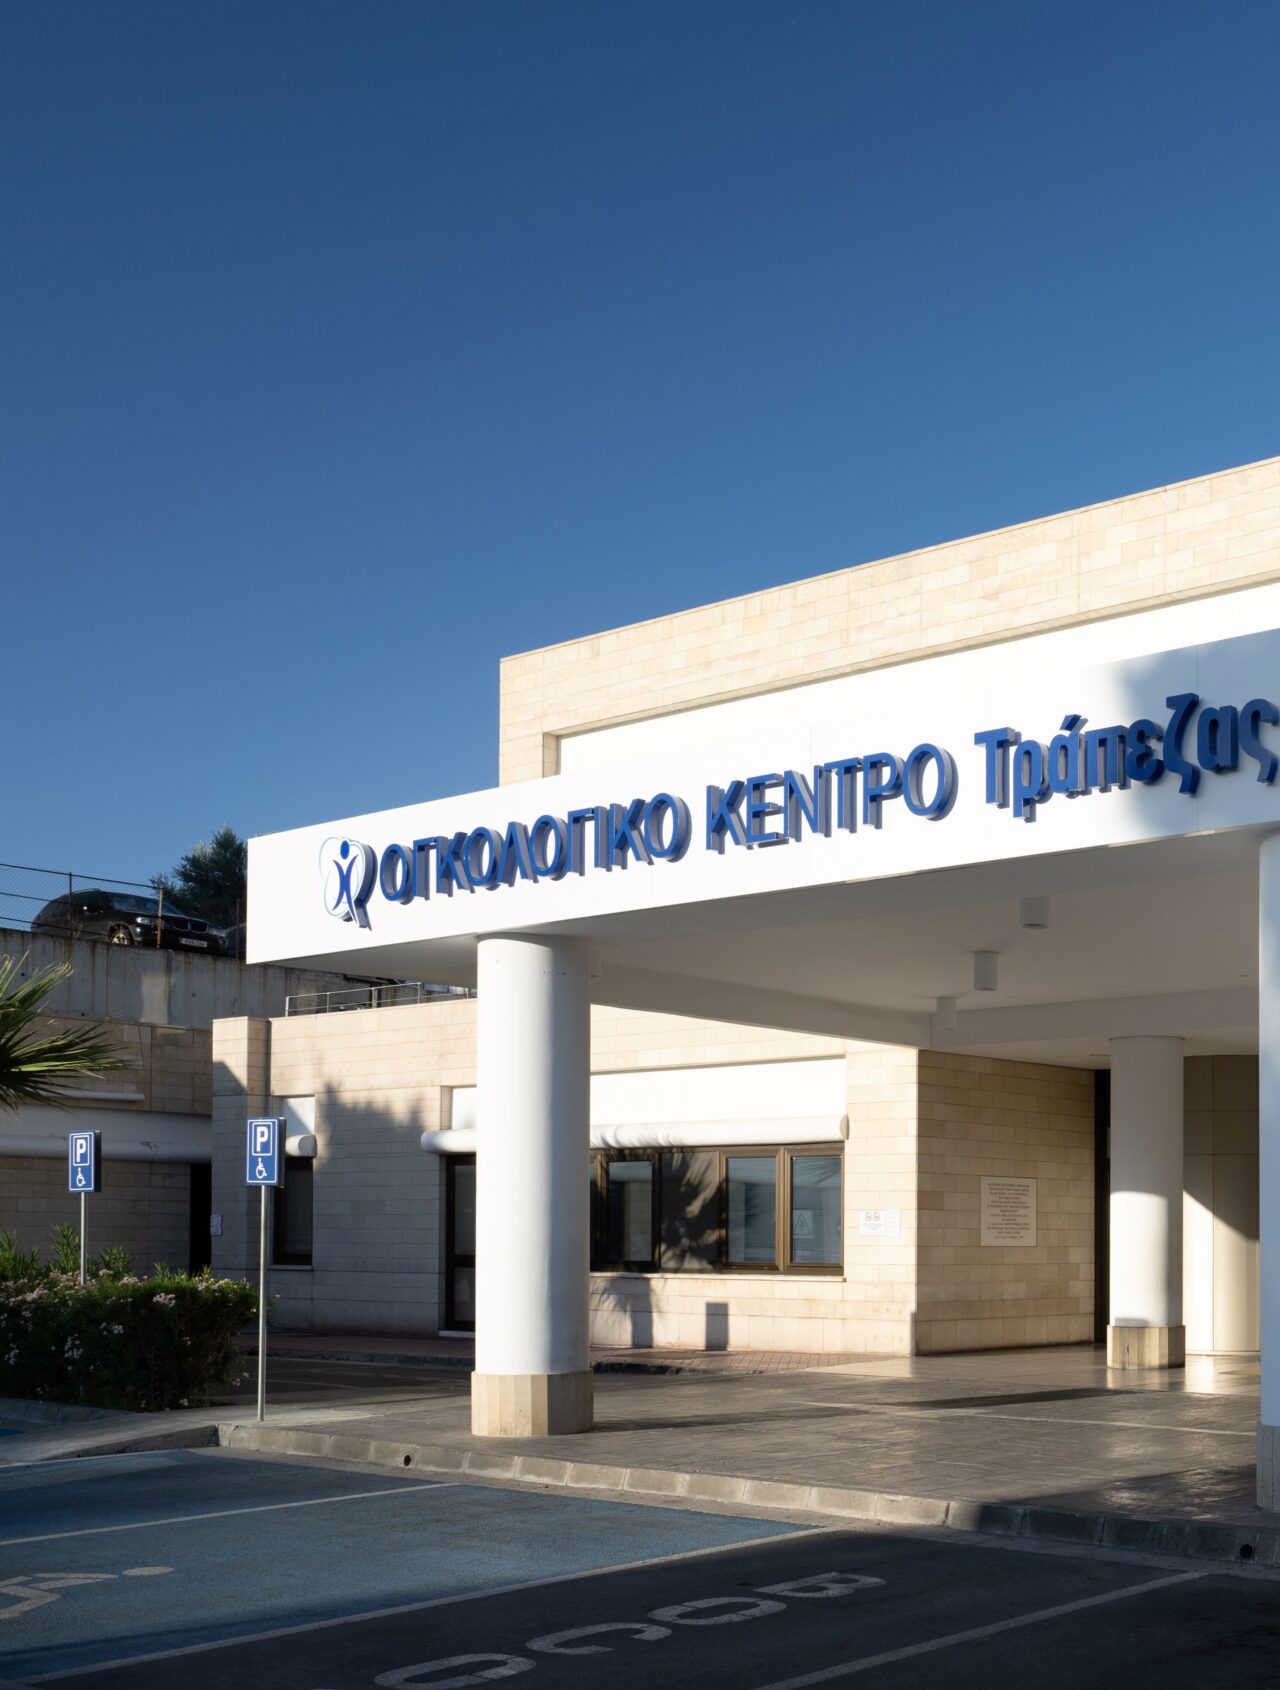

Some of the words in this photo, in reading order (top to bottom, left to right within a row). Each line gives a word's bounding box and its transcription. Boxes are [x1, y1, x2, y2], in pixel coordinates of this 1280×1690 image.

[379, 793, 692, 905] ΟΓΚΟΛΟΓΙΚΟ
[706, 743, 959, 854] ΚΕΝΤΡΟ
[974, 692, 1280, 822] Τράπεζας
[76, 1139, 86, 1162] P
[256, 1126, 269, 1152] P
